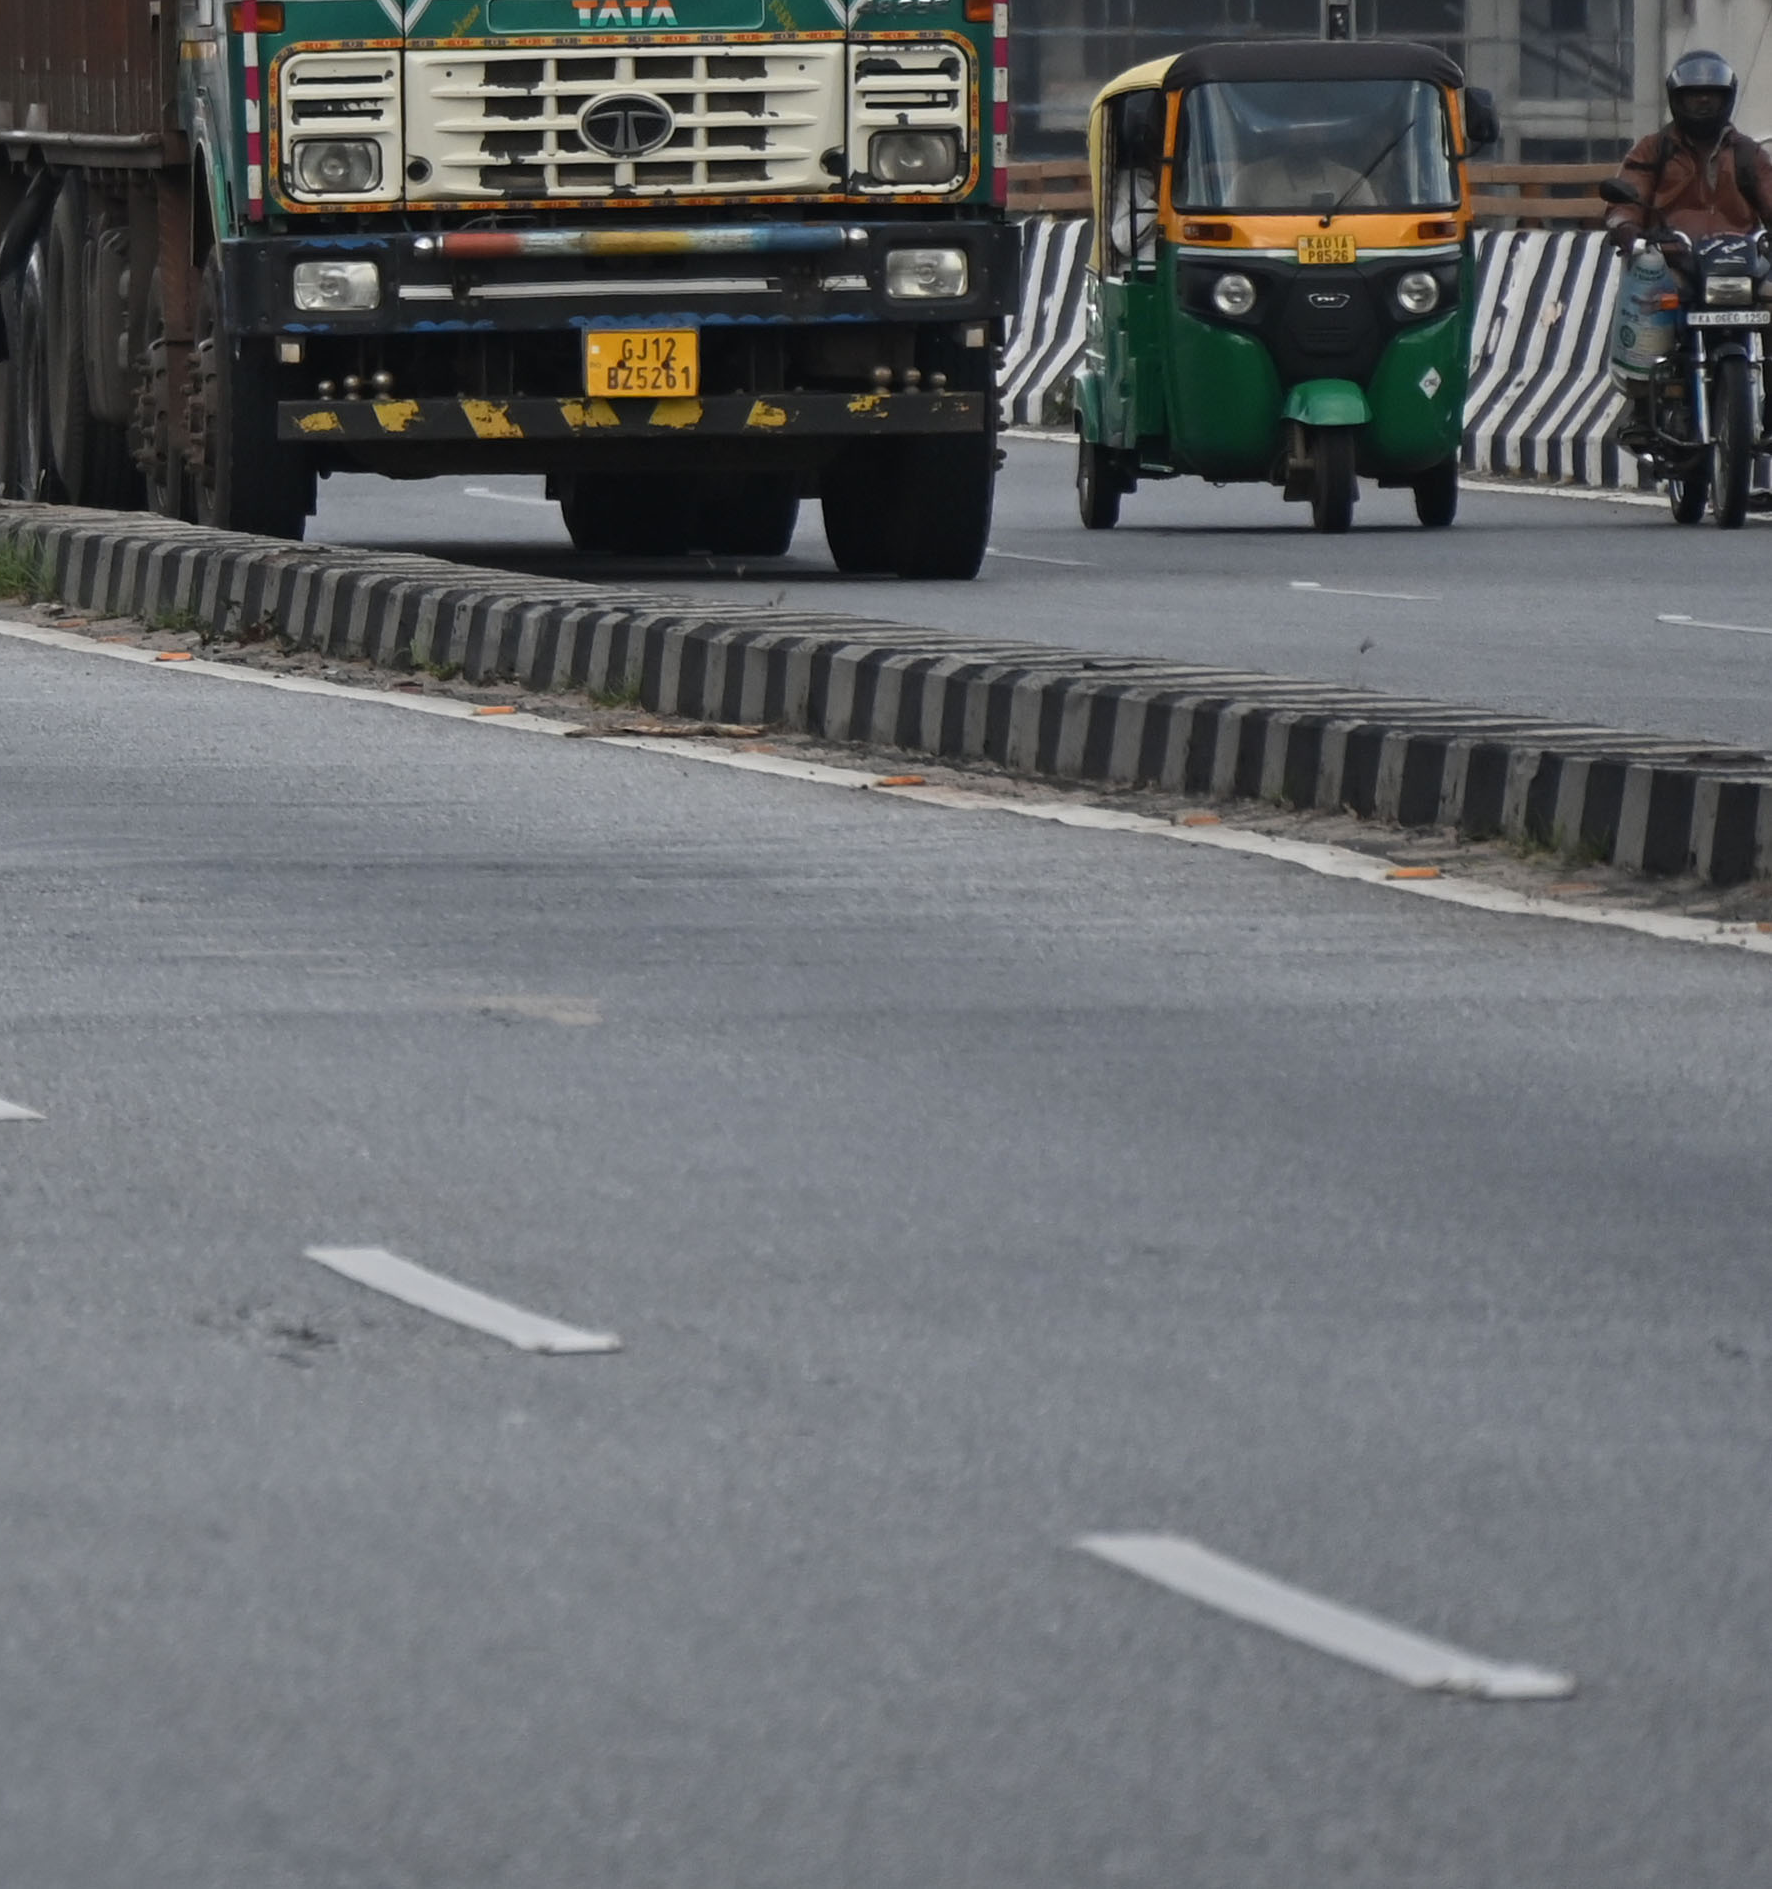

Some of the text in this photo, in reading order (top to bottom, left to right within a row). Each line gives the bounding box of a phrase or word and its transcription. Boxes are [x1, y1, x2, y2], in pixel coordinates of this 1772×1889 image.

[1307, 237, 1348, 249] KA01A
[1307, 250, 1349, 263] P8526
[621, 337, 677, 361] GJ12
[607, 365, 691, 390] BZ5261
